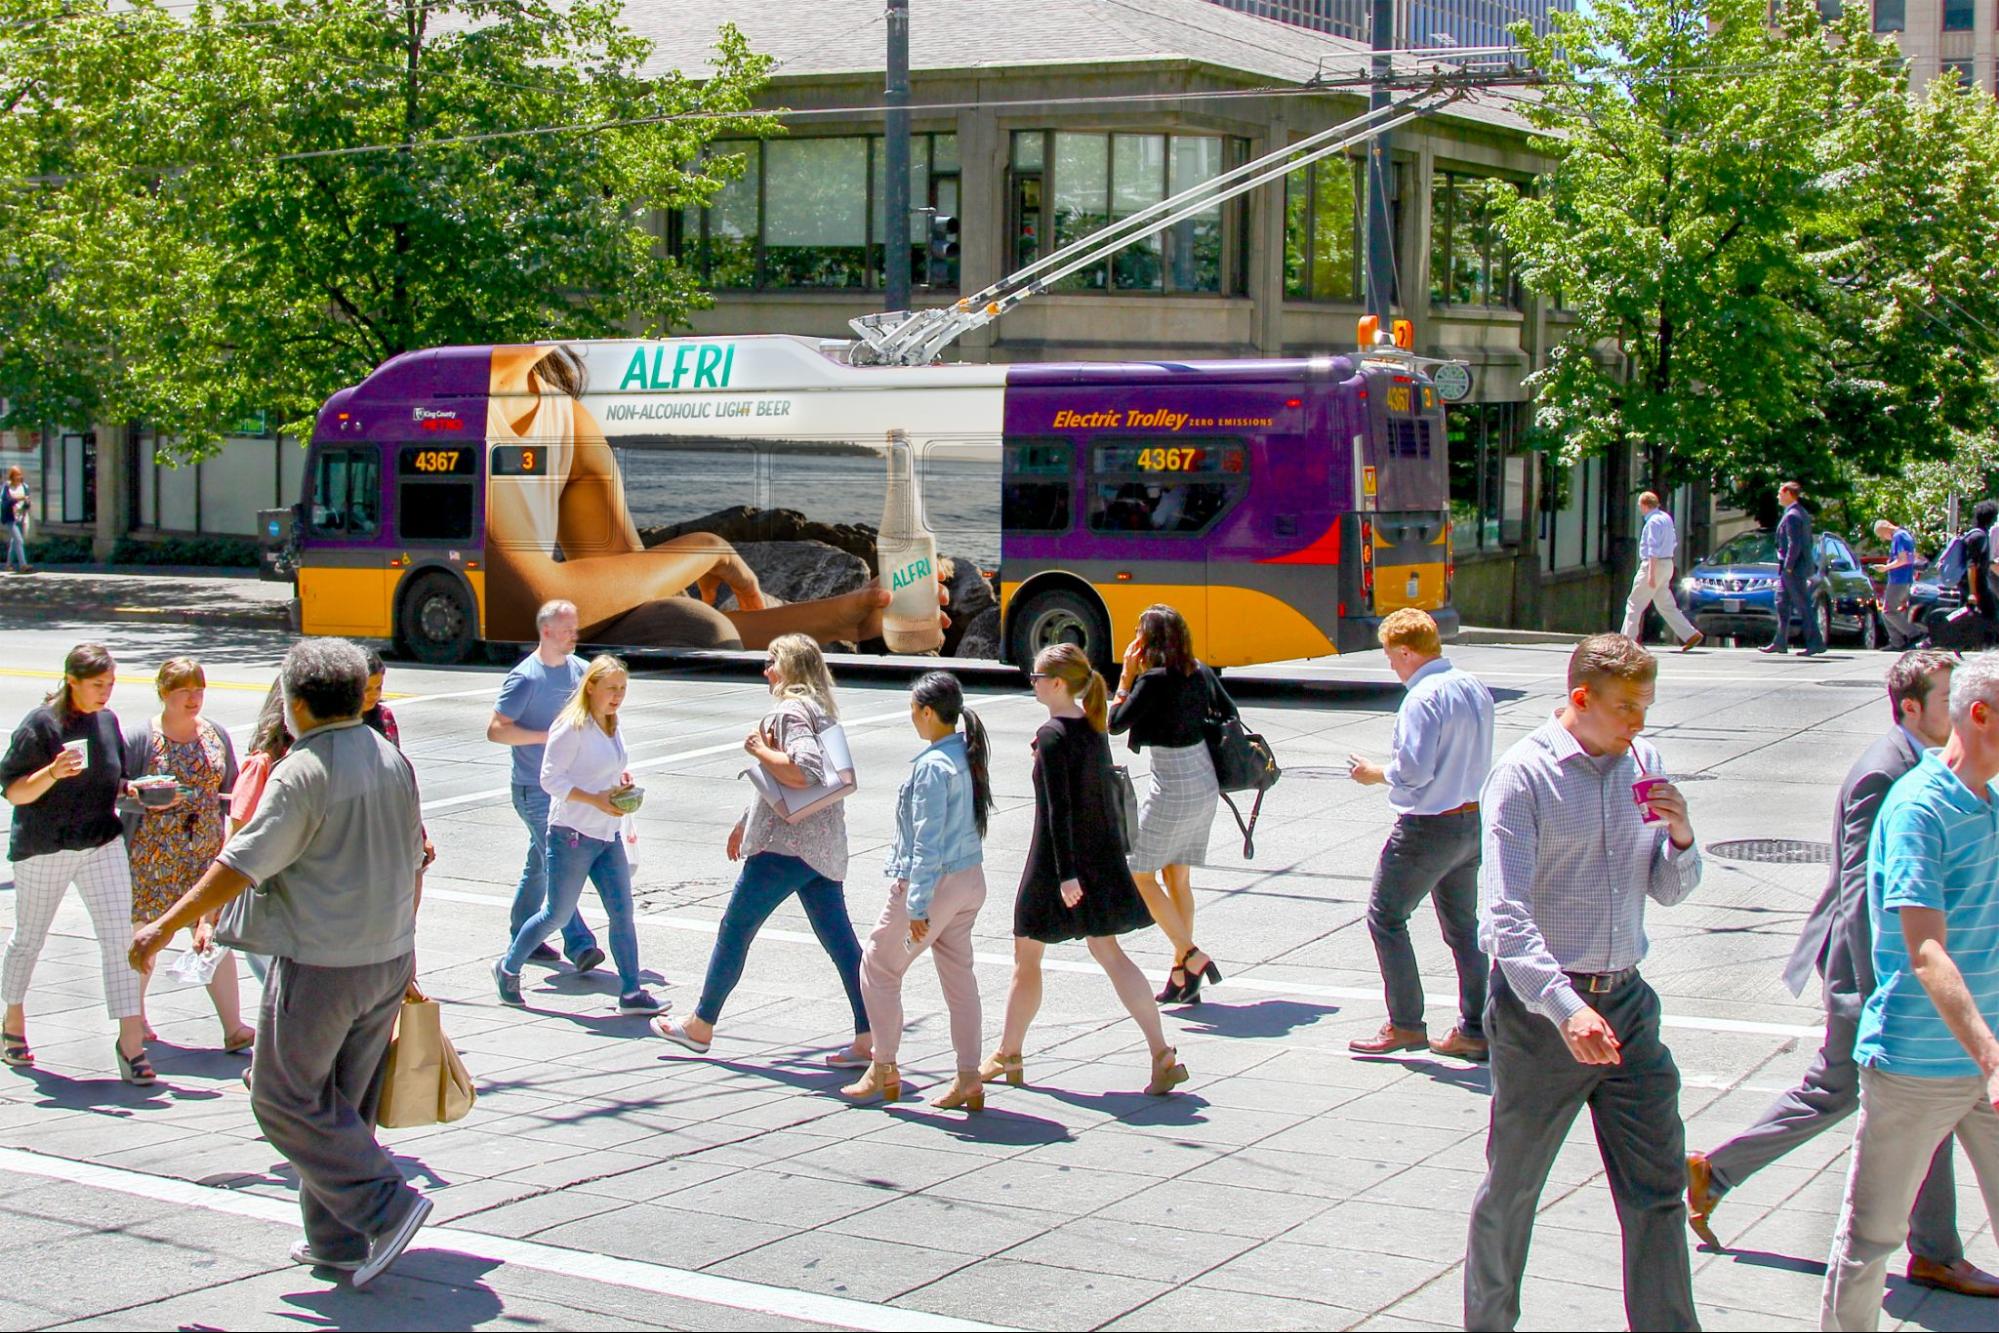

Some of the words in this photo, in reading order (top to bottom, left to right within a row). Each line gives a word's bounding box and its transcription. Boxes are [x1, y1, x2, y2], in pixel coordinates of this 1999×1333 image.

[619, 343, 735, 390] ALFRI
[423, 410, 436, 419] King
[436, 410, 456, 419] County
[606, 402, 711, 420] NON-ALCOHOLIC
[715, 401, 753, 417] LIGHT
[756, 400, 791, 416] BEER
[1053, 409, 1121, 428] Electric
[1126, 408, 1189, 431] Trolley
[1189, 418, 1214, 427] ZERO
[1218, 418, 1273, 427] EMISSIONS
[415, 452, 459, 471] 4367
[522, 452, 534, 470] 3
[1137, 448, 1196, 470] 4367
[893, 557, 931, 592] ALFRI
